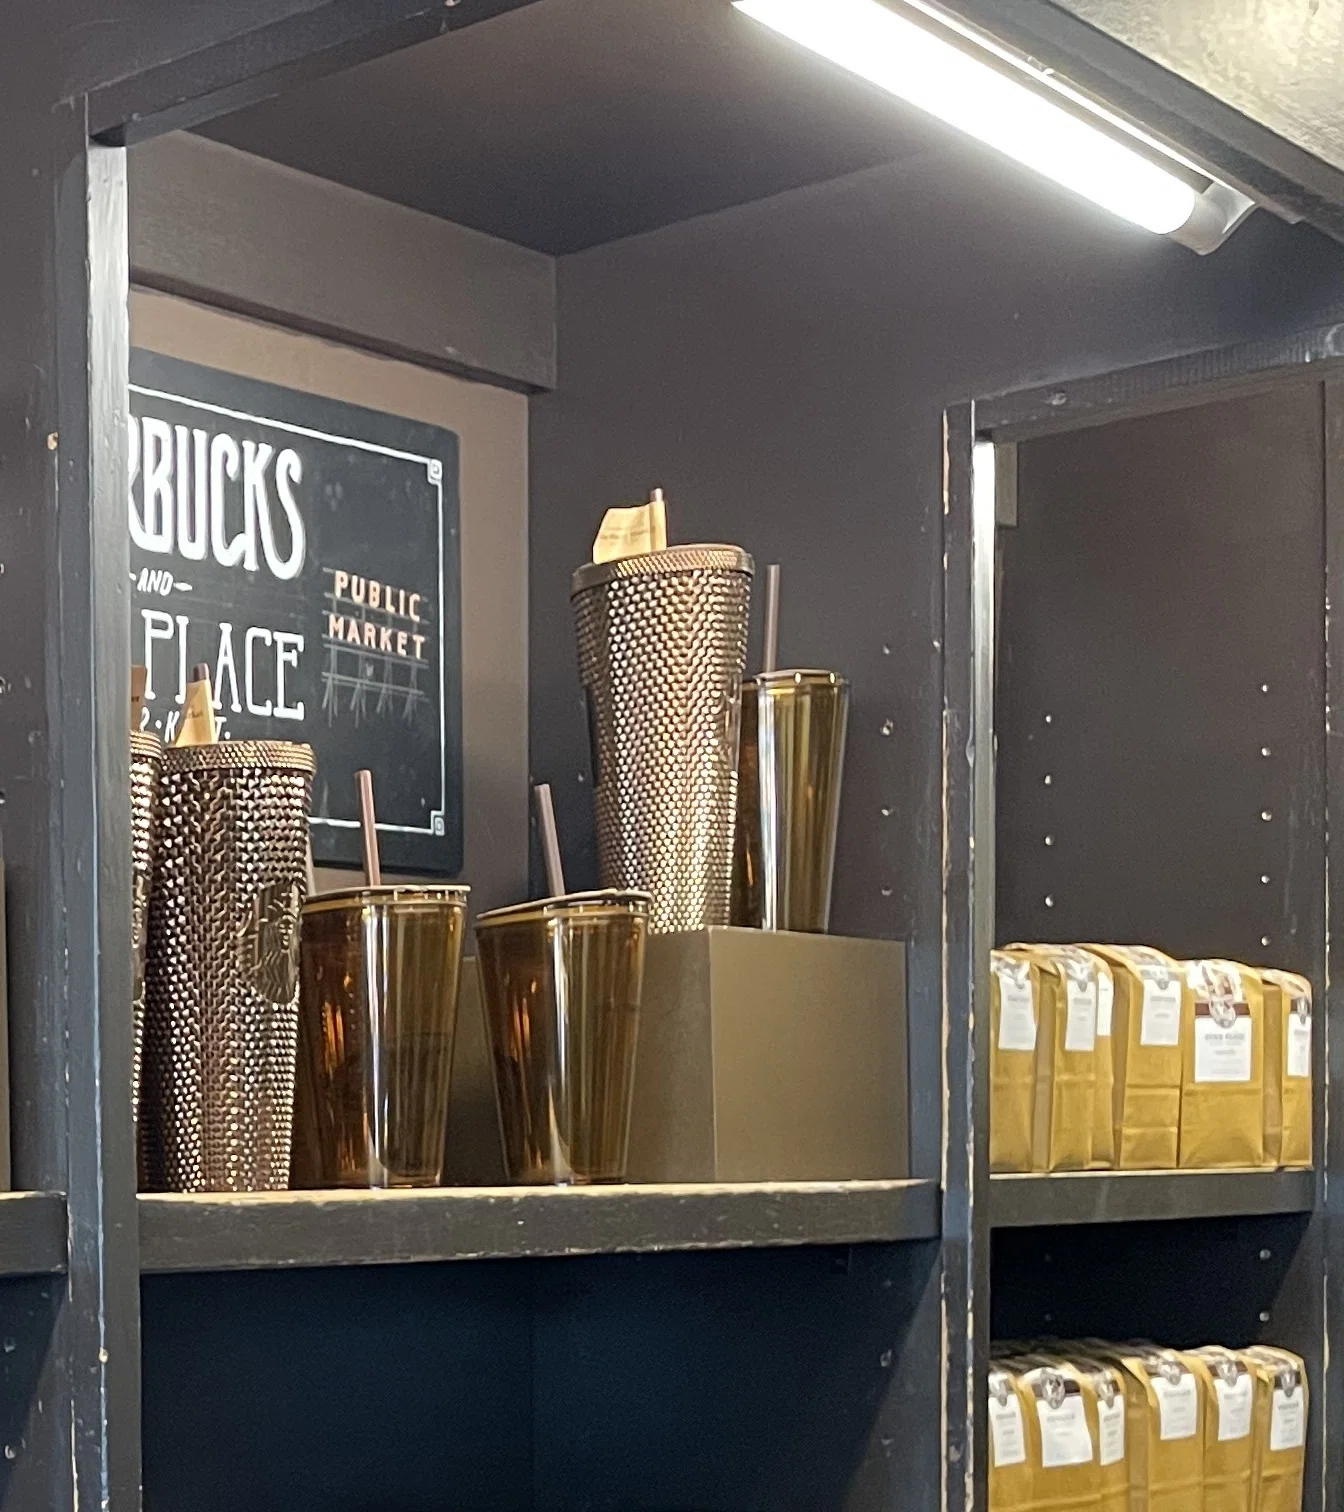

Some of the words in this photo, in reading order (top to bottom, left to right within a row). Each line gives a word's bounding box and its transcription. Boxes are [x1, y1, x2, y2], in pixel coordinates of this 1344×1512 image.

[128, 413, 305, 581] RBUCKS
[137, 567, 174, 597] AND
[335, 570, 421, 624] PUBLIC
[328, 613, 426, 660] MARKET
